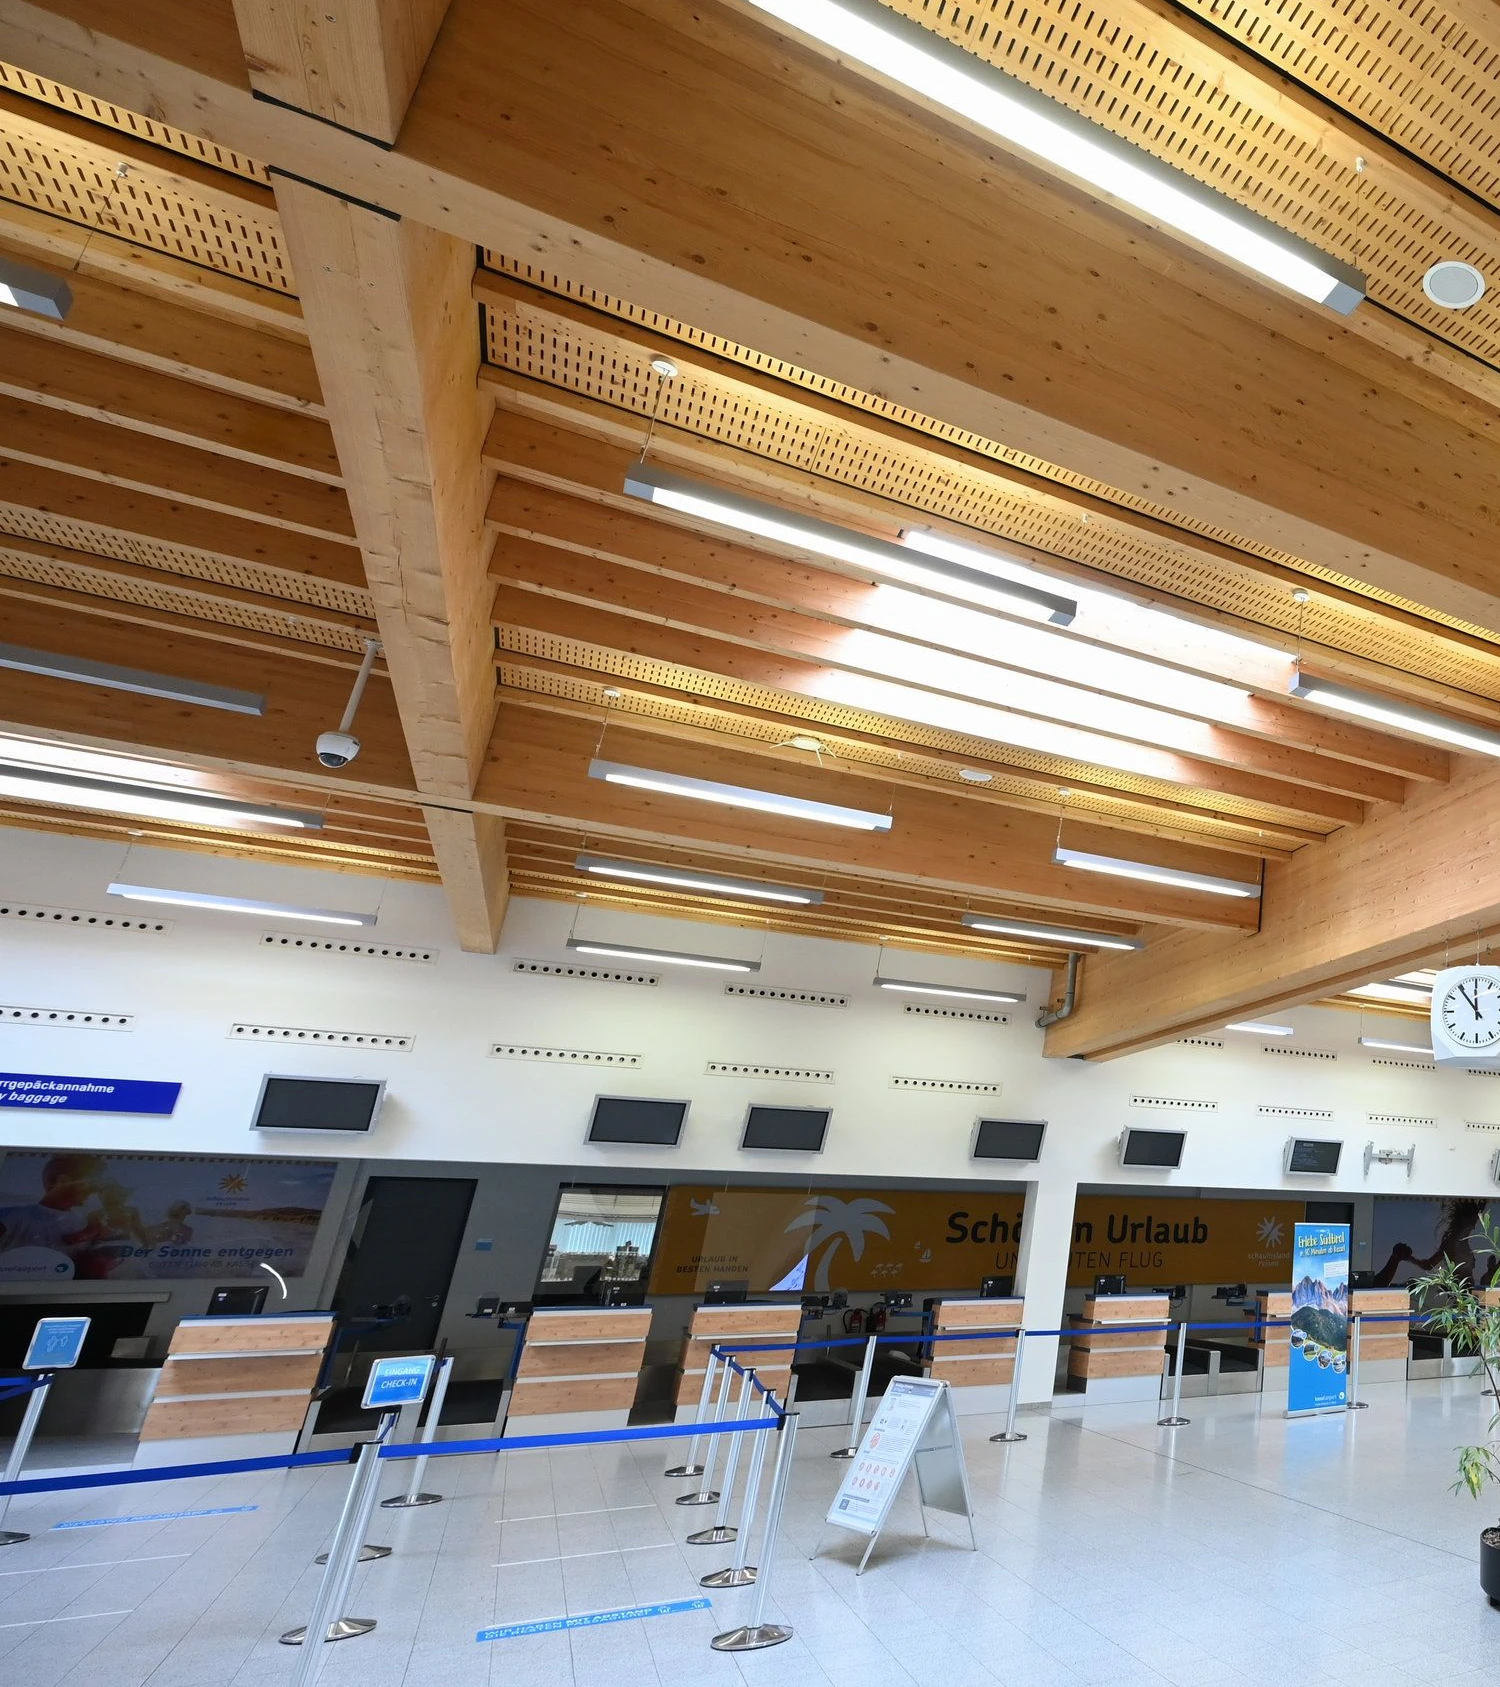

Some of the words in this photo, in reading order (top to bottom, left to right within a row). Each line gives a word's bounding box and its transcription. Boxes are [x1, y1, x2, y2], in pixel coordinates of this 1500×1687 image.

[8, 1091, 68, 1105] baggage
[1107, 1214, 1208, 1244] Urlaub
[120, 1245, 152, 1258] Der
[157, 1245, 212, 1258] Sonne
[217, 1246, 294, 1259] entgegen
[1118, 1251, 1163, 1268] FLUG
[676, 1265, 710, 1273] BESTEN
[384, 1366, 421, 1376] EINGANG
[381, 1378, 418, 1389] CHECK-IN
